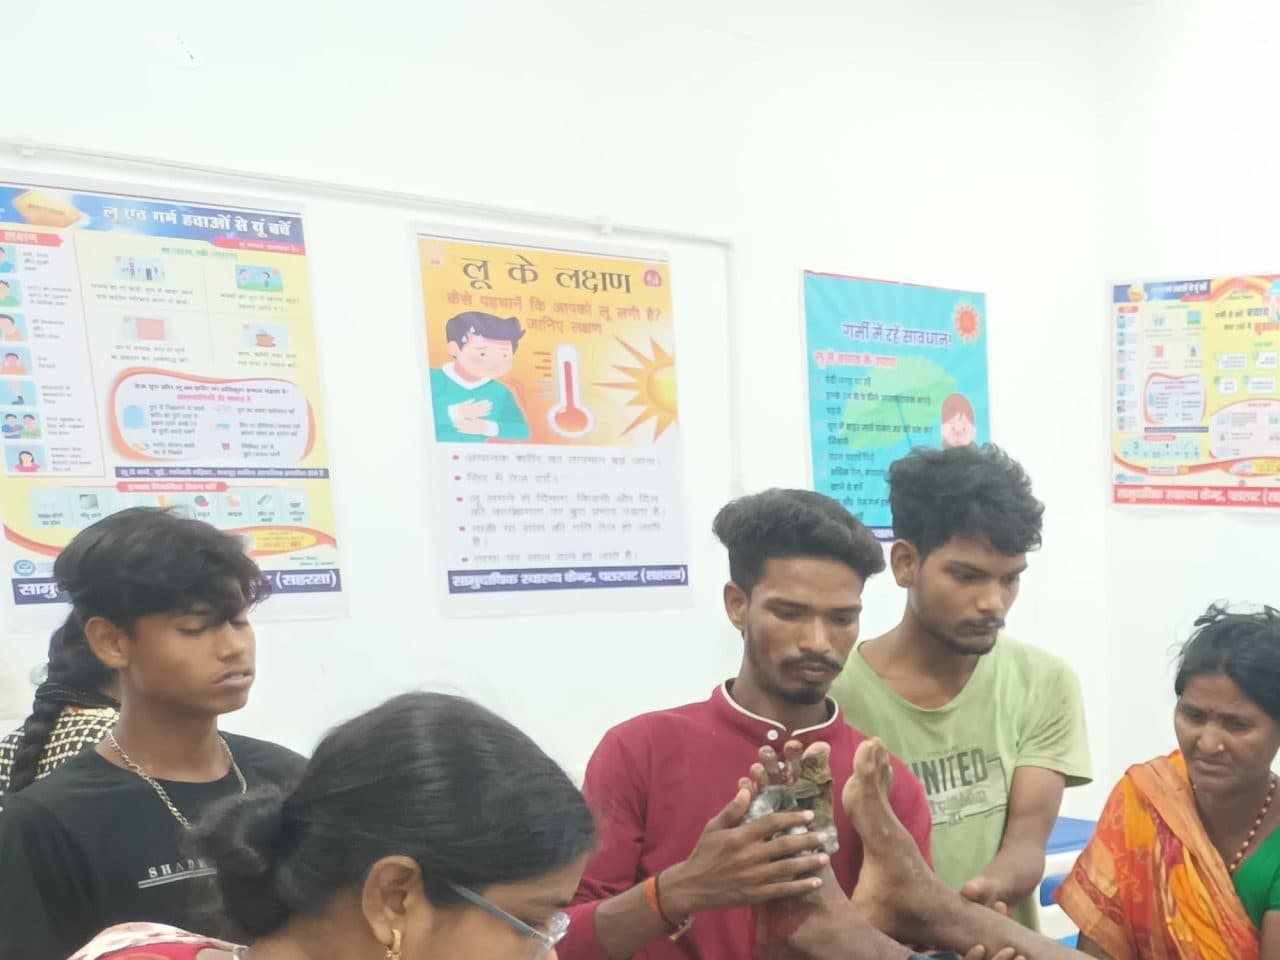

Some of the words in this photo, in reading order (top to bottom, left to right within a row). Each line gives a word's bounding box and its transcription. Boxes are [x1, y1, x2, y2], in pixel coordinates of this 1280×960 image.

[152, 208, 177, 224] गर्म
[234, 215, 249, 232] से
[460, 256, 493, 290] लू
[504, 254, 539, 285] के
[554, 266, 632, 294] लक्षण
[447, 290, 473, 306] कैसे
[529, 296, 545, 312] कि
[553, 300, 592, 317] आपको
[842, 320, 869, 340] गर्मी
